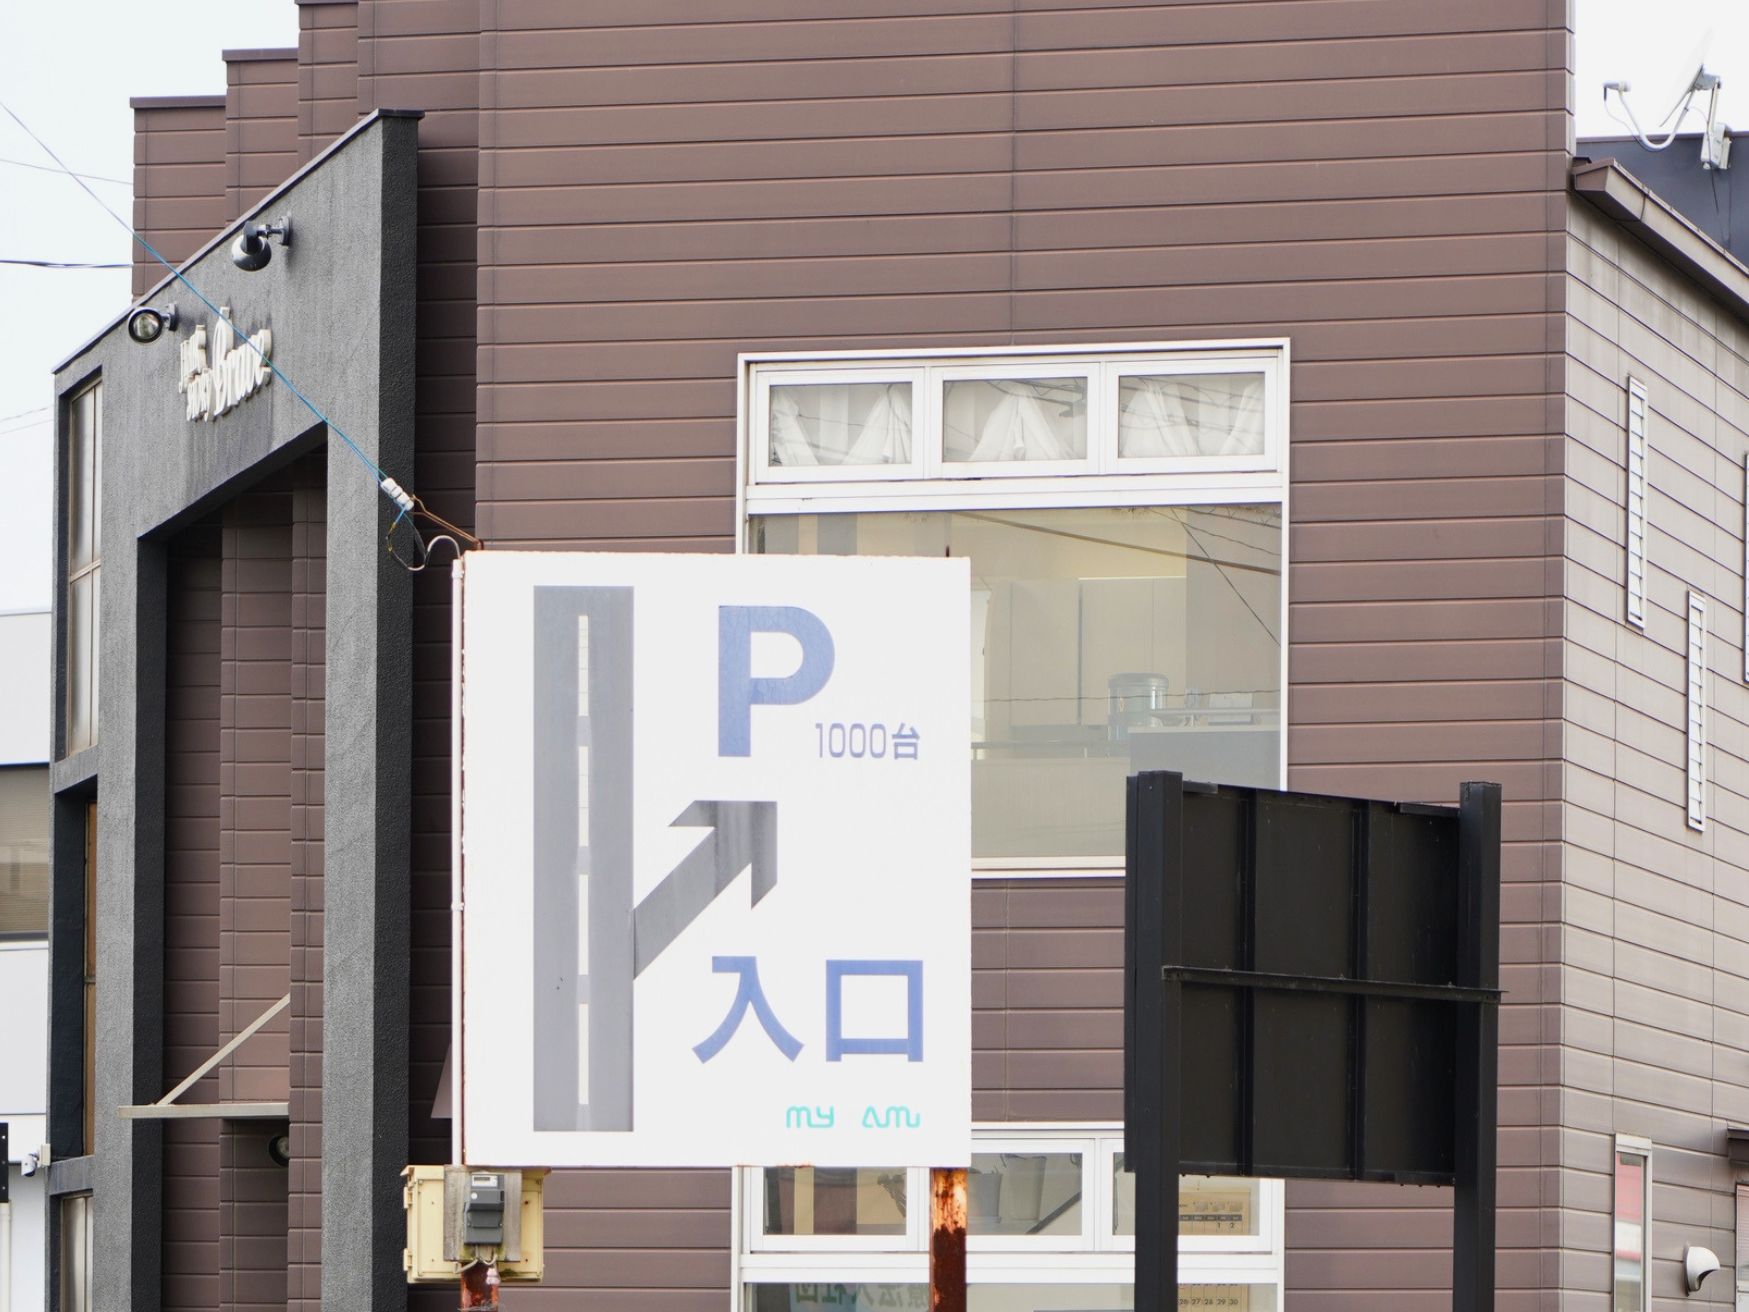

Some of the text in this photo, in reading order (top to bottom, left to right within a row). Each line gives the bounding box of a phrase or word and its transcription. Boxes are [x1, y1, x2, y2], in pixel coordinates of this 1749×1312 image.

[718, 604, 836, 757] P
[814, 722, 920, 760] 1000台
[692, 955, 924, 1064] 入口
[785, 1104, 836, 1130] my
